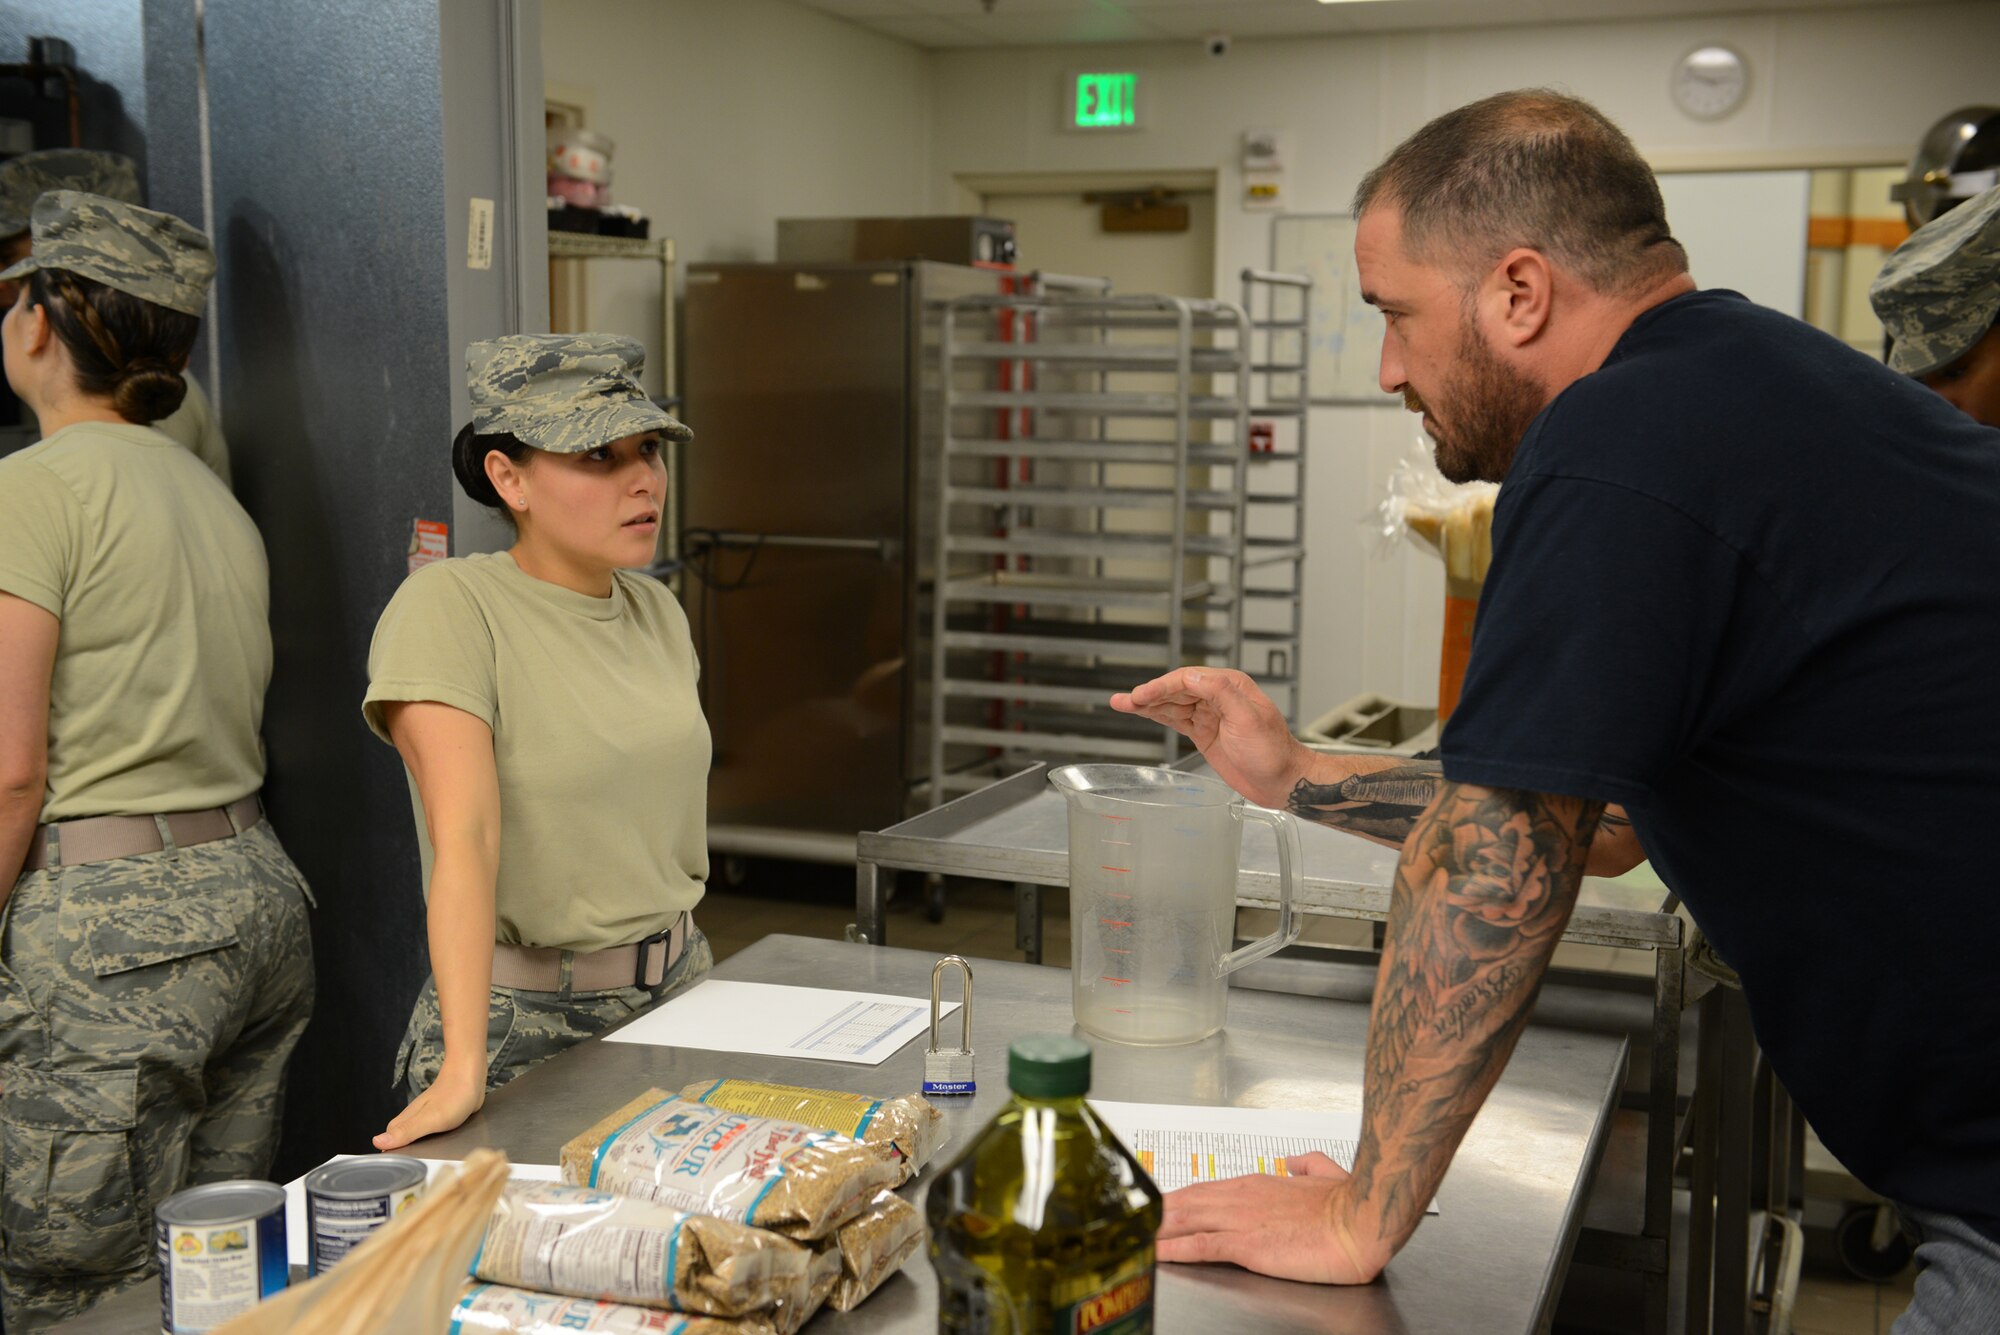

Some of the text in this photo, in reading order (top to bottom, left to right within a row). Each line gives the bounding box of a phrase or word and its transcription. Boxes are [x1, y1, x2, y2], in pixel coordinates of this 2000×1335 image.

[1076, 73, 1137, 126] EXIT
[932, 1083, 968, 1091] Master
[673, 1114, 750, 1177] ULGUR
